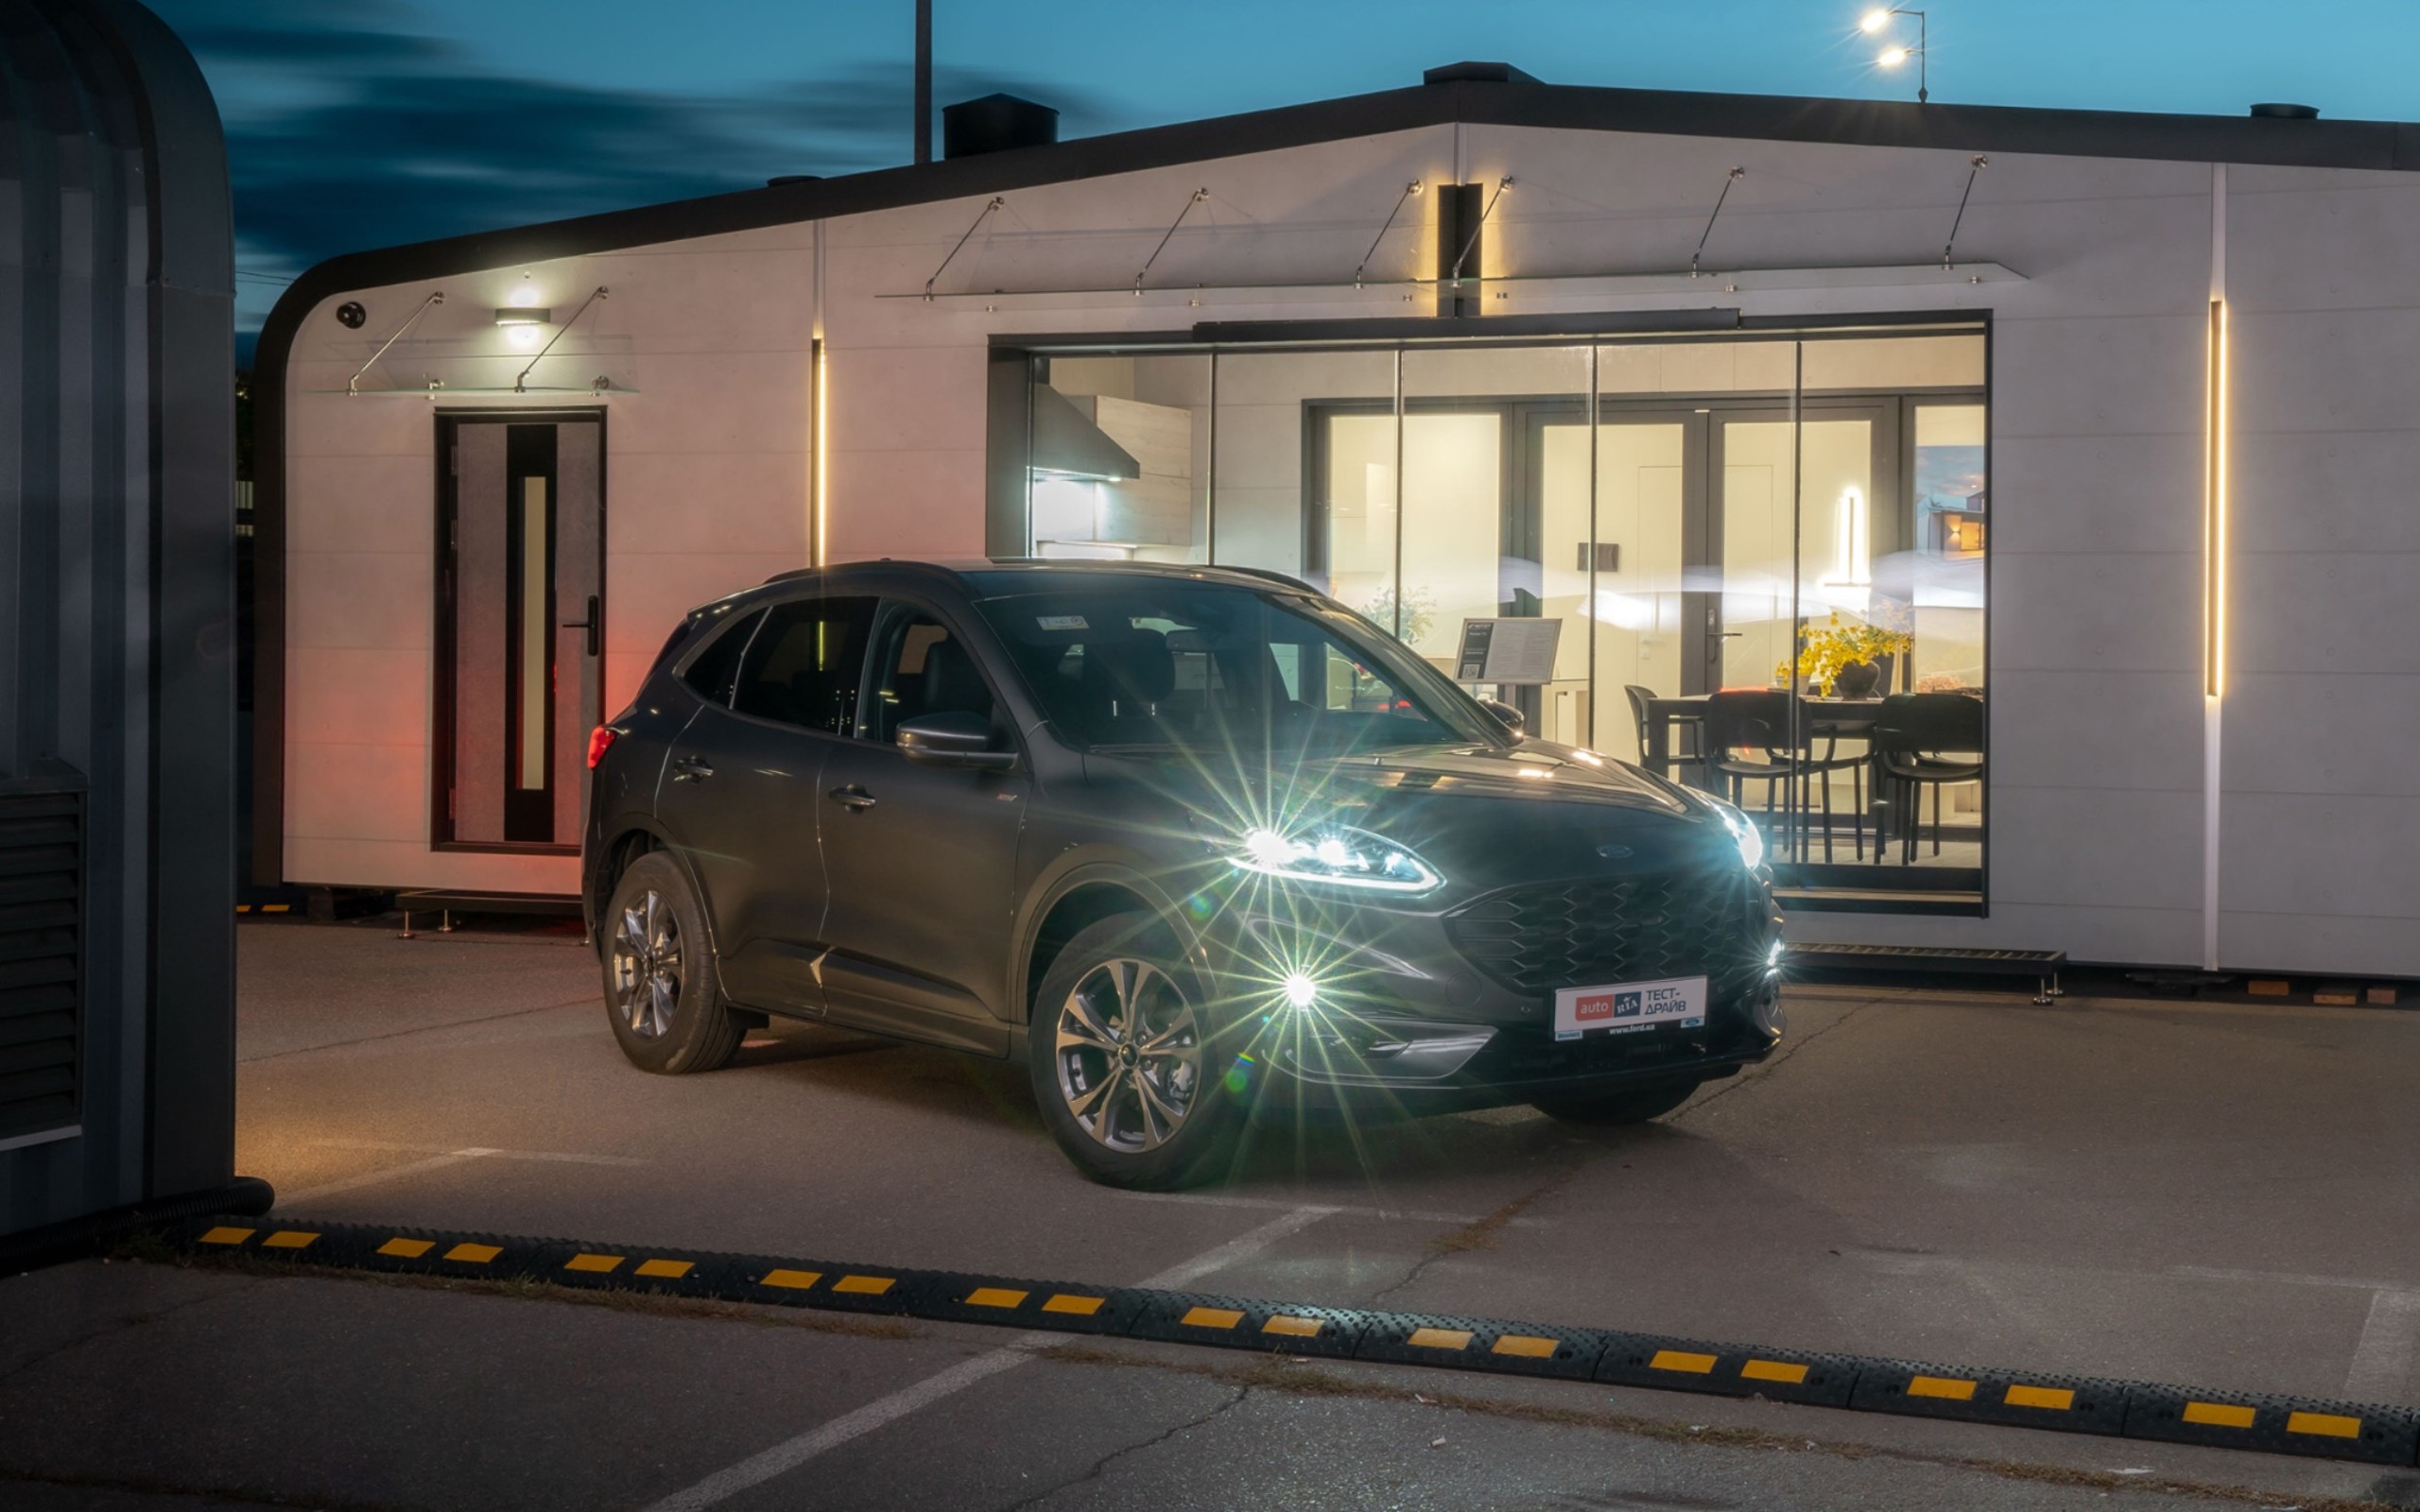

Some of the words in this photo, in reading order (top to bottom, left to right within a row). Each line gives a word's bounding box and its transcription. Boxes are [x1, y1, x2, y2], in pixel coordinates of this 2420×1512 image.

[1646, 988, 1681, 1001] ТЕСТ-
[1581, 1001, 1609, 1014] auto
[1616, 997, 1638, 1014] RIA
[1645, 1001, 1686, 1015] ДРАЙВ
[1609, 1023, 1655, 1035] www.ford.ua
